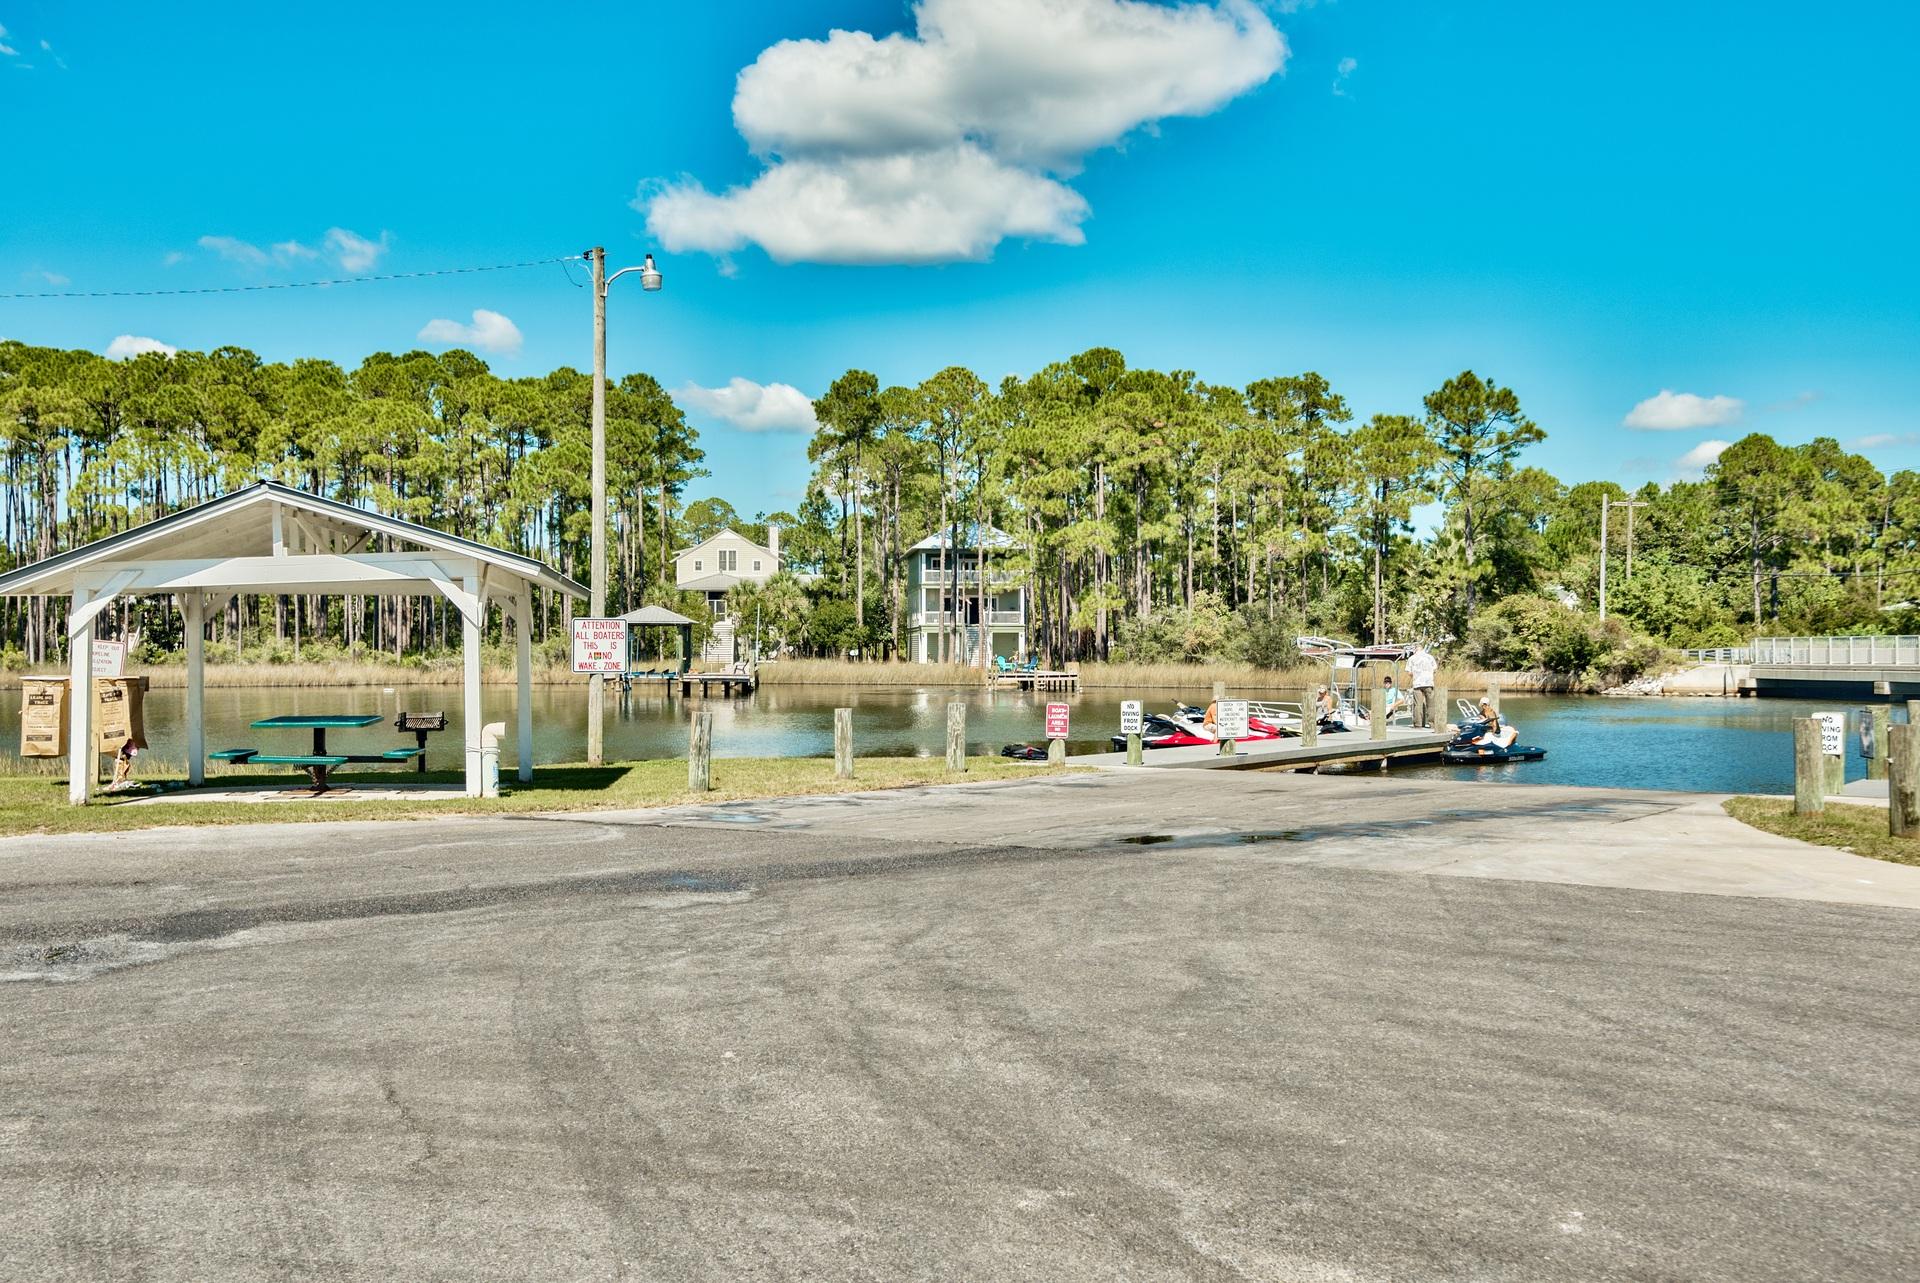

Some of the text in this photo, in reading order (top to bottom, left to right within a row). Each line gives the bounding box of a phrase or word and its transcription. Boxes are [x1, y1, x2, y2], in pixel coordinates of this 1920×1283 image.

[581, 621, 621, 630] ATTENTION
[575, 631, 625, 640] ALL BOATERS
[583, 641, 617, 650] THIS IS
[588, 651, 613, 660] A NO
[578, 661, 622, 670] WAKE ZONE
[1822, 716, 1834, 724] NO
[1821, 734, 1838, 742] ROM
[1821, 743, 1838, 751] OCK
